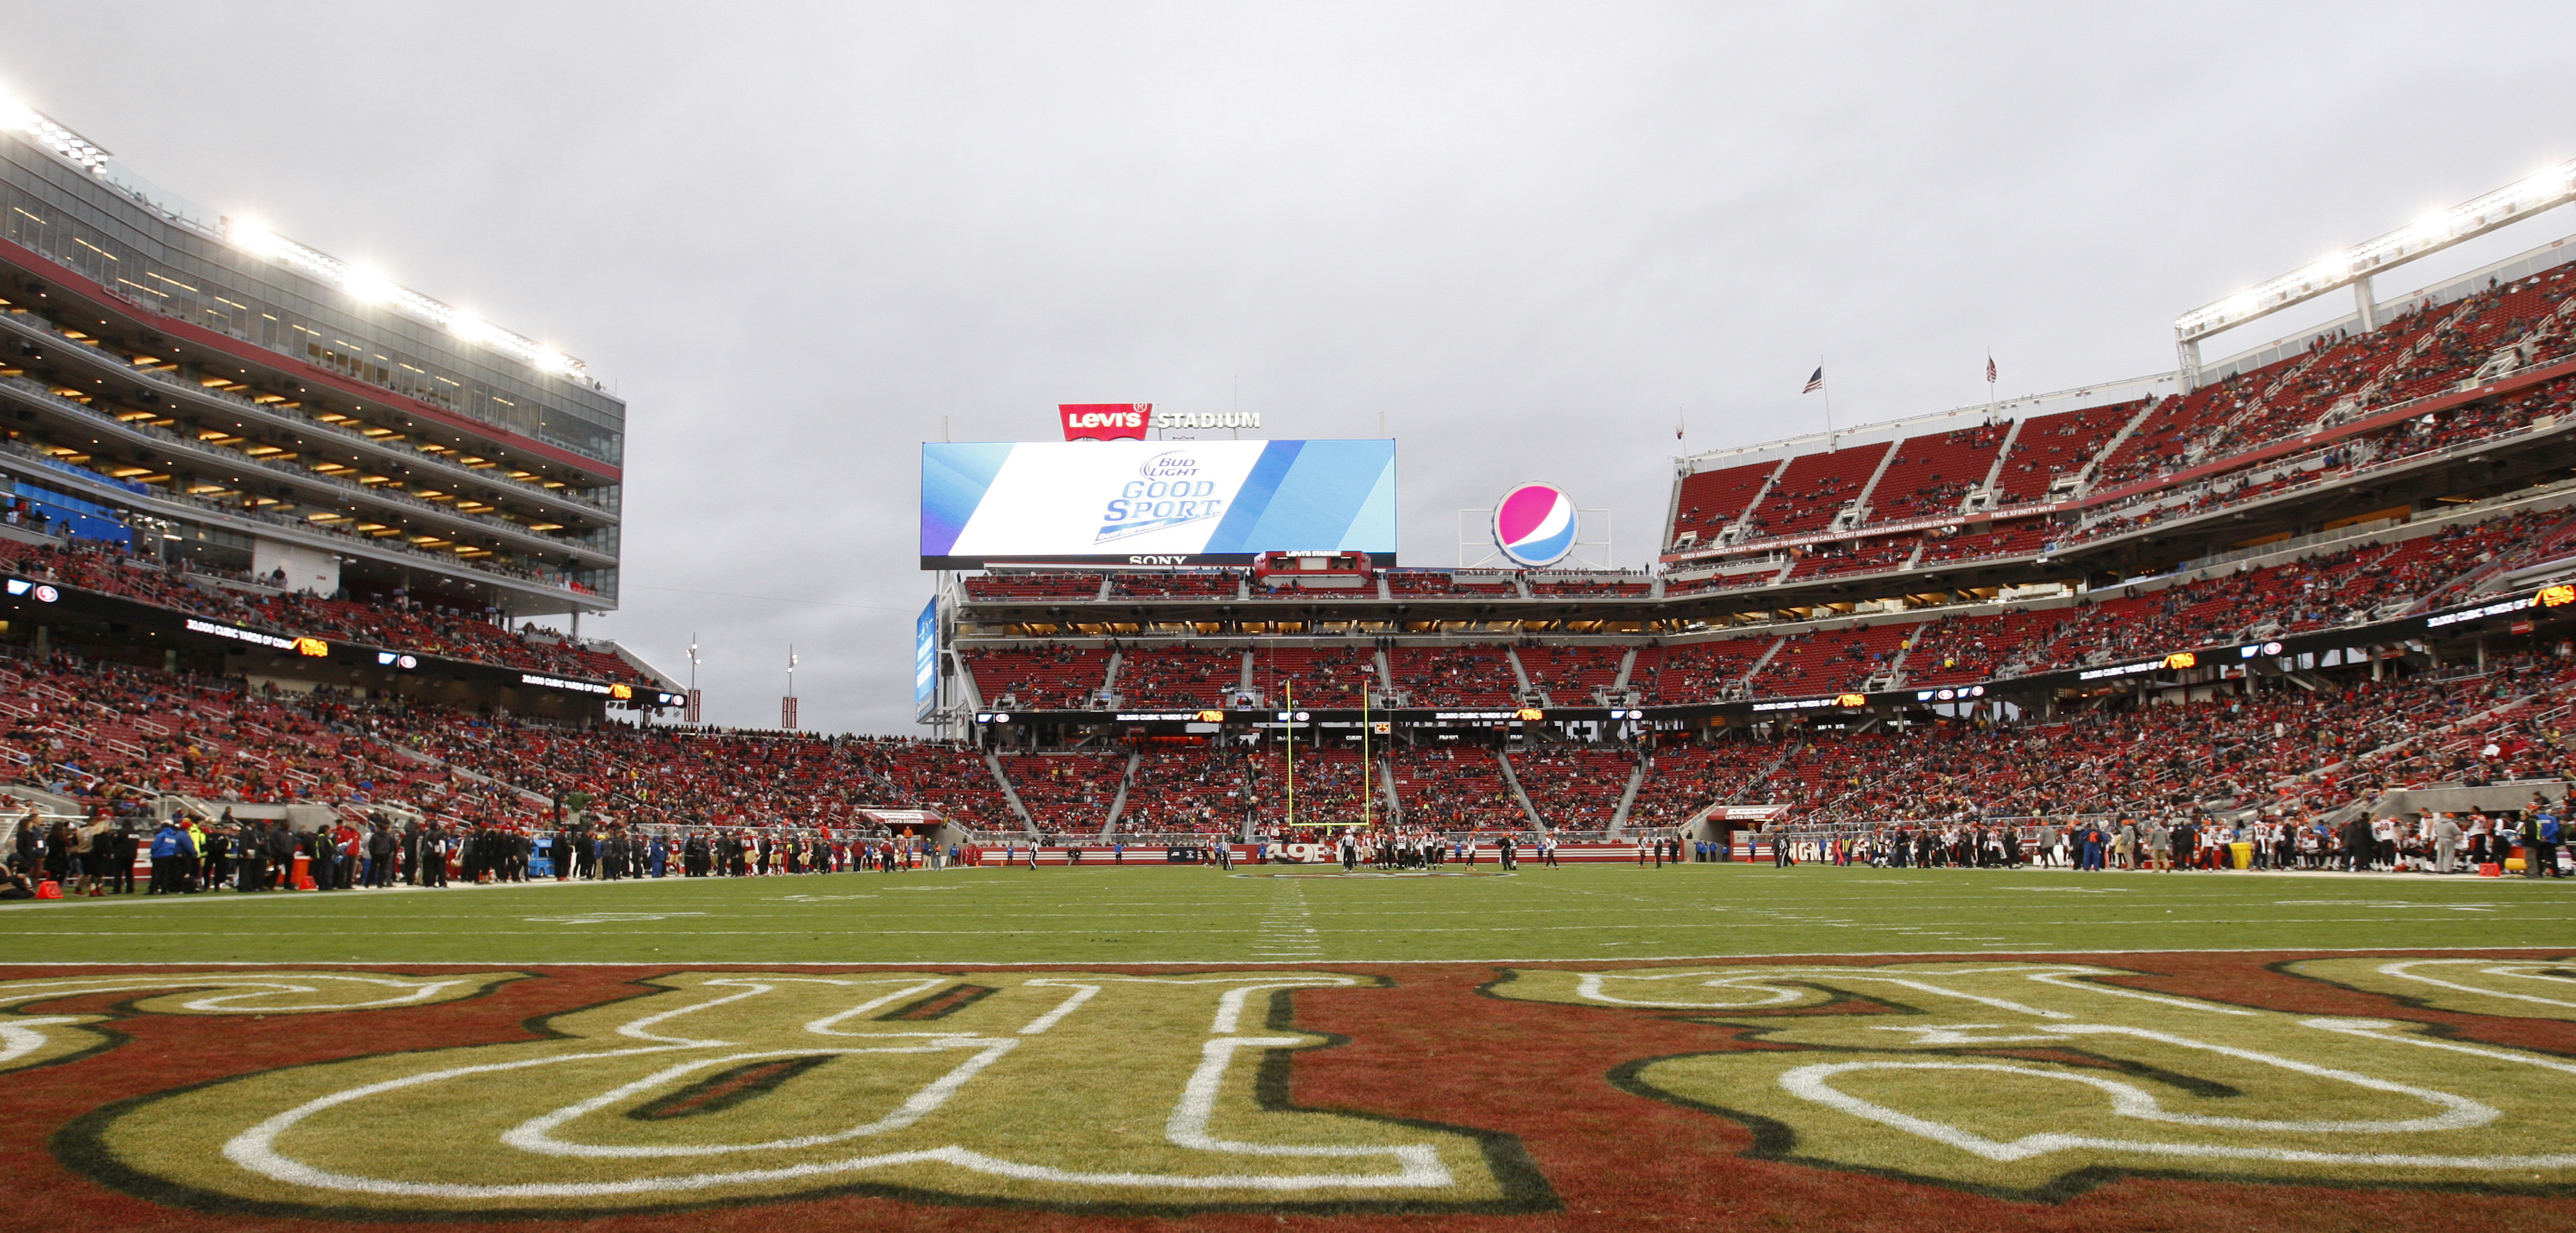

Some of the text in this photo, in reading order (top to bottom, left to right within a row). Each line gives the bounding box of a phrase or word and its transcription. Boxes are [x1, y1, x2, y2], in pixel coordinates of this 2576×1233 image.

[1069, 411, 1261, 429] LEVI'S STADIUM
[1158, 457, 1196, 467] BUD
[1149, 467, 1200, 476] LIGHT
[1122, 480, 1215, 499] GOOD
[1104, 499, 1221, 522] SPORT
[2009, 507, 2037, 517] XFINITY
[2038, 505, 2057, 513] WI-FI
[1696, 548, 1731, 558] ASSISTANCE?
[1856, 528, 1885, 537] SERVICES
[1885, 524, 1913, 533] HOTLINE
[1933, 517, 1965, 527] 579-4600
[1129, 555, 1187, 565] SONY
[215, 625, 238, 639] CUBIC
[238, 630, 262, 644] YARDS
[262, 635, 273, 645] OF
[545, 678, 564, 688] CUBIC
[564, 681, 584, 691] YARDS
[584, 684, 594, 692] OF
[1376, 723, 1389, 732] 25
[2257, 827, 2267, 835] 12
